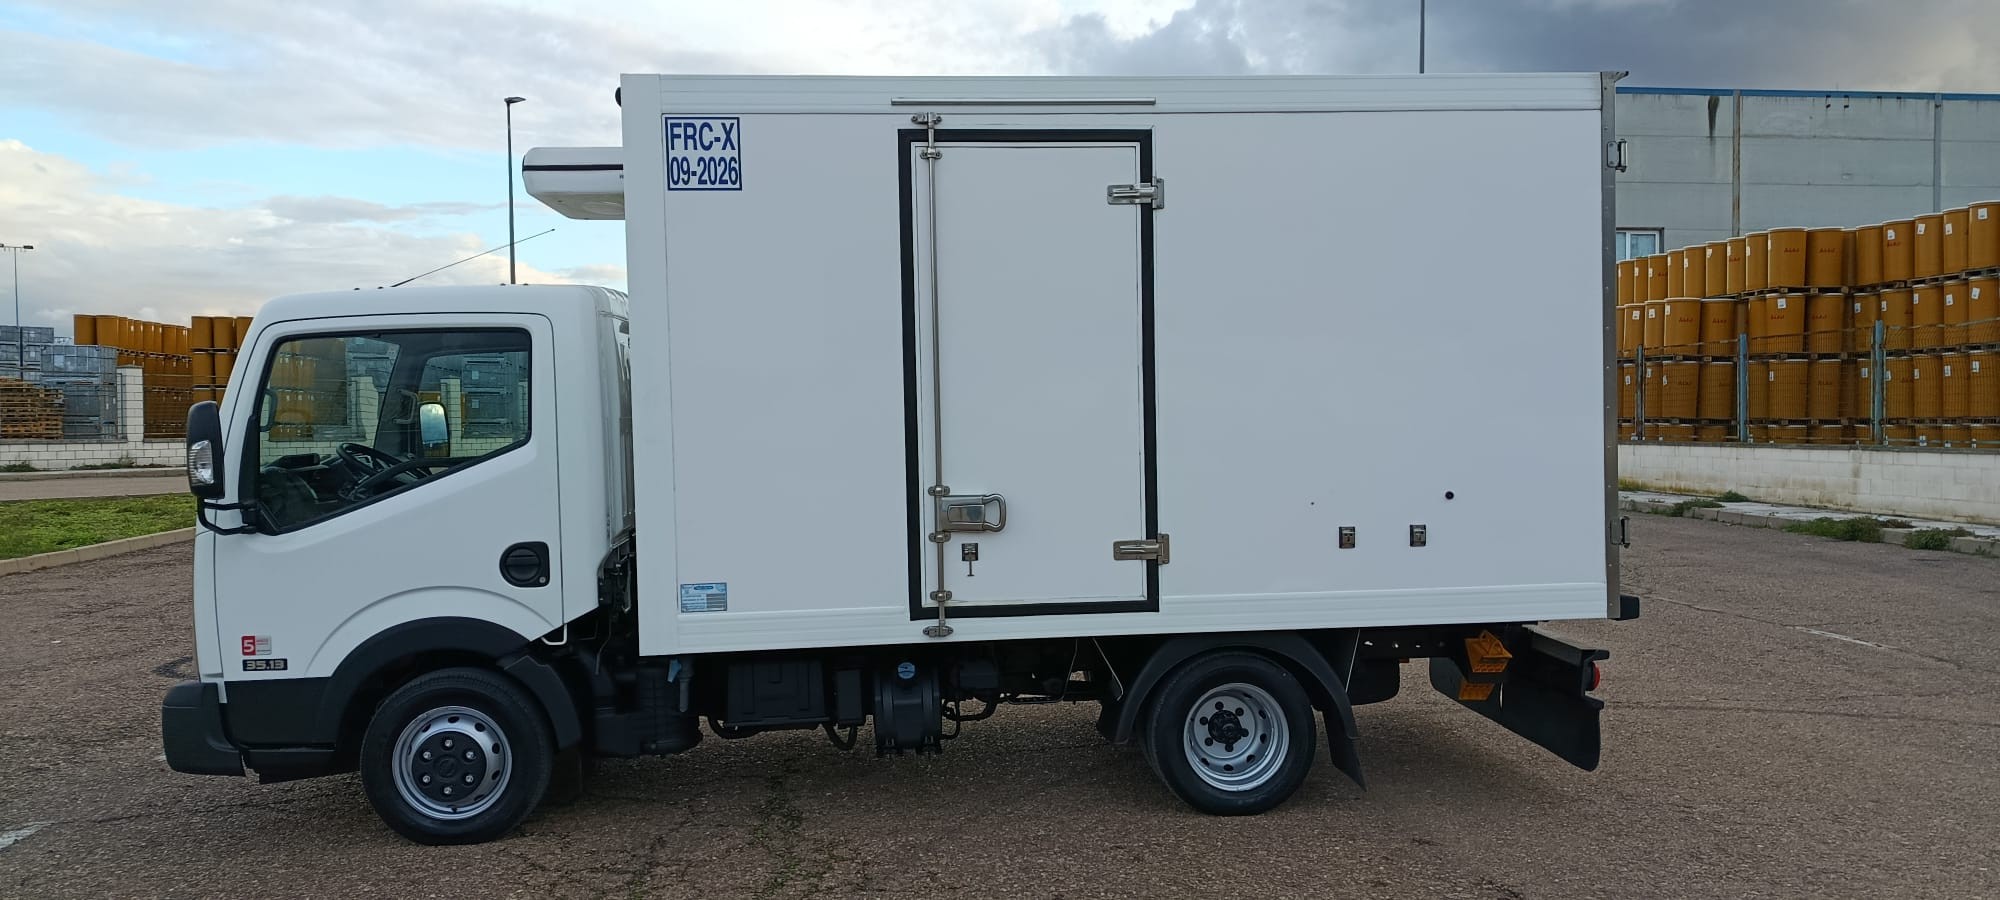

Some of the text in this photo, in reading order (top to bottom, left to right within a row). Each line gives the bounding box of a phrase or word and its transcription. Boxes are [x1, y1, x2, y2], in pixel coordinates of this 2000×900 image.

[669, 122, 736, 151] FRC-X
[670, 156, 739, 186] 09-2026
[243, 639, 254, 653] 5
[246, 660, 284, 670] 35.13
